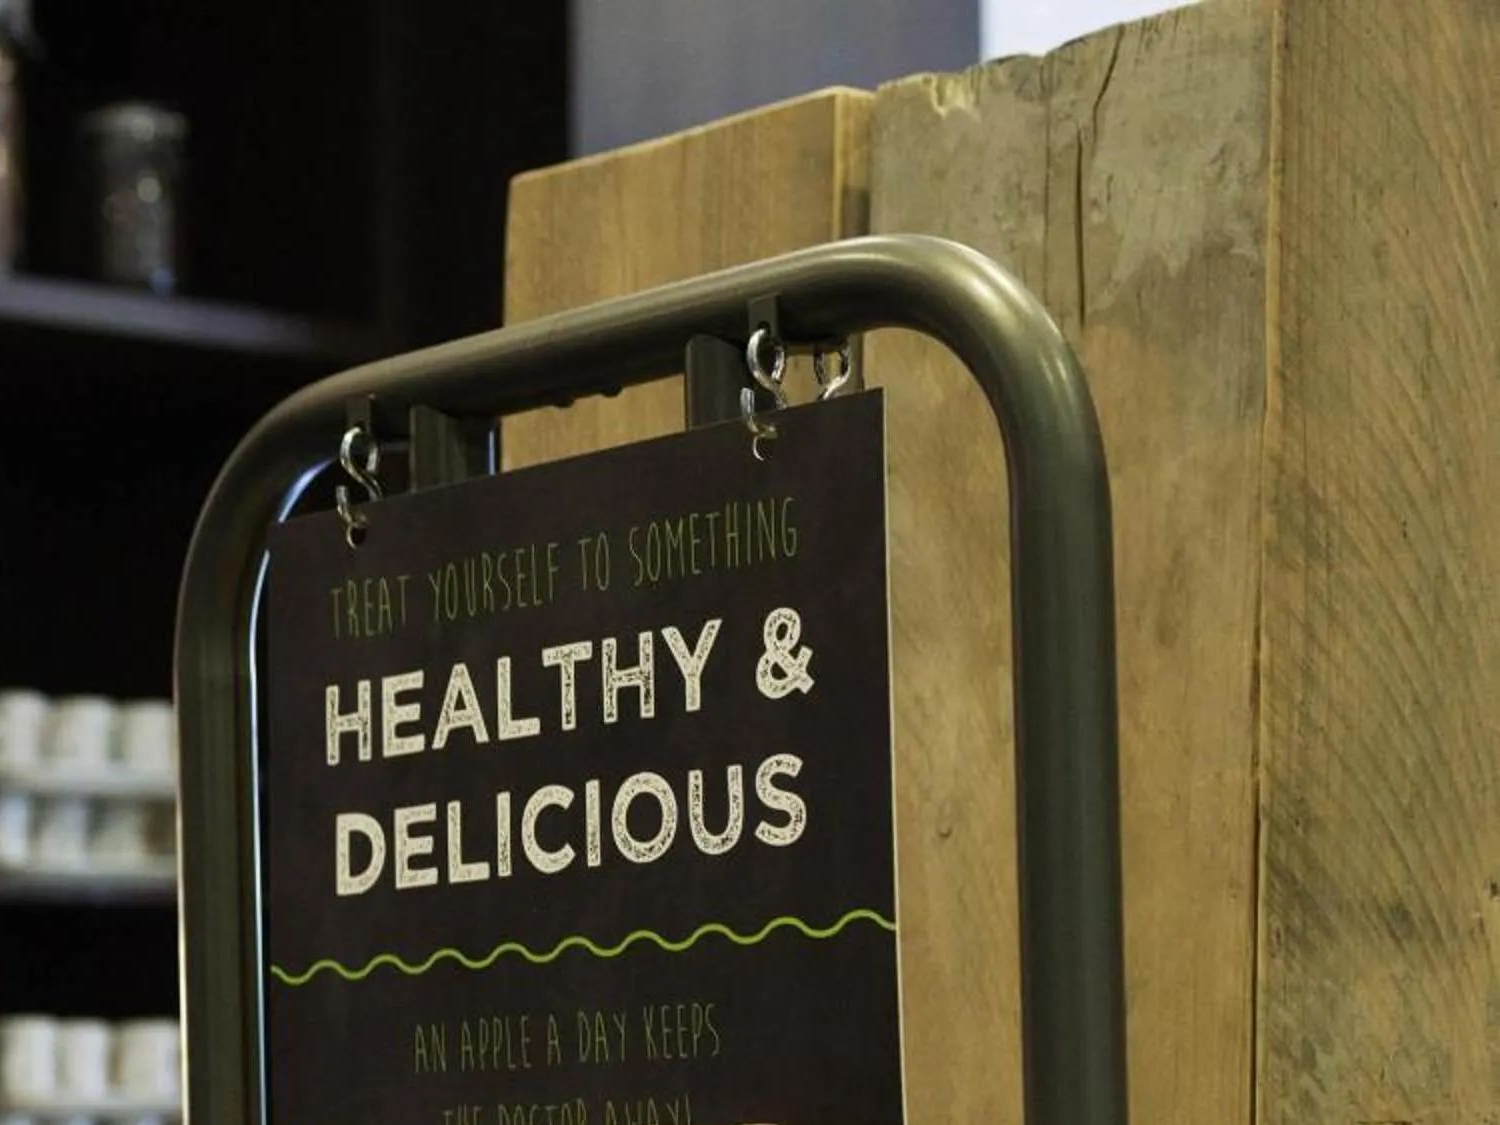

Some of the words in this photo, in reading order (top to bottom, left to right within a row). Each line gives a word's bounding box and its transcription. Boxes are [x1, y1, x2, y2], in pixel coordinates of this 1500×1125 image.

[330, 575, 410, 640] TREAT
[428, 542, 559, 624] YOURSELF
[578, 532, 610, 593] TO
[628, 497, 798, 588] SOMETHING
[325, 618, 722, 766] HEALTHY
[756, 606, 815, 700] &
[335, 753, 807, 896] DELICIOUS
[414, 1021, 448, 1074] AN
[460, 1014, 533, 1071] APPLE
[547, 1013, 562, 1067] A
[577, 1009, 628, 1066] DAY
[643, 1002, 721, 1061] KEEPS
